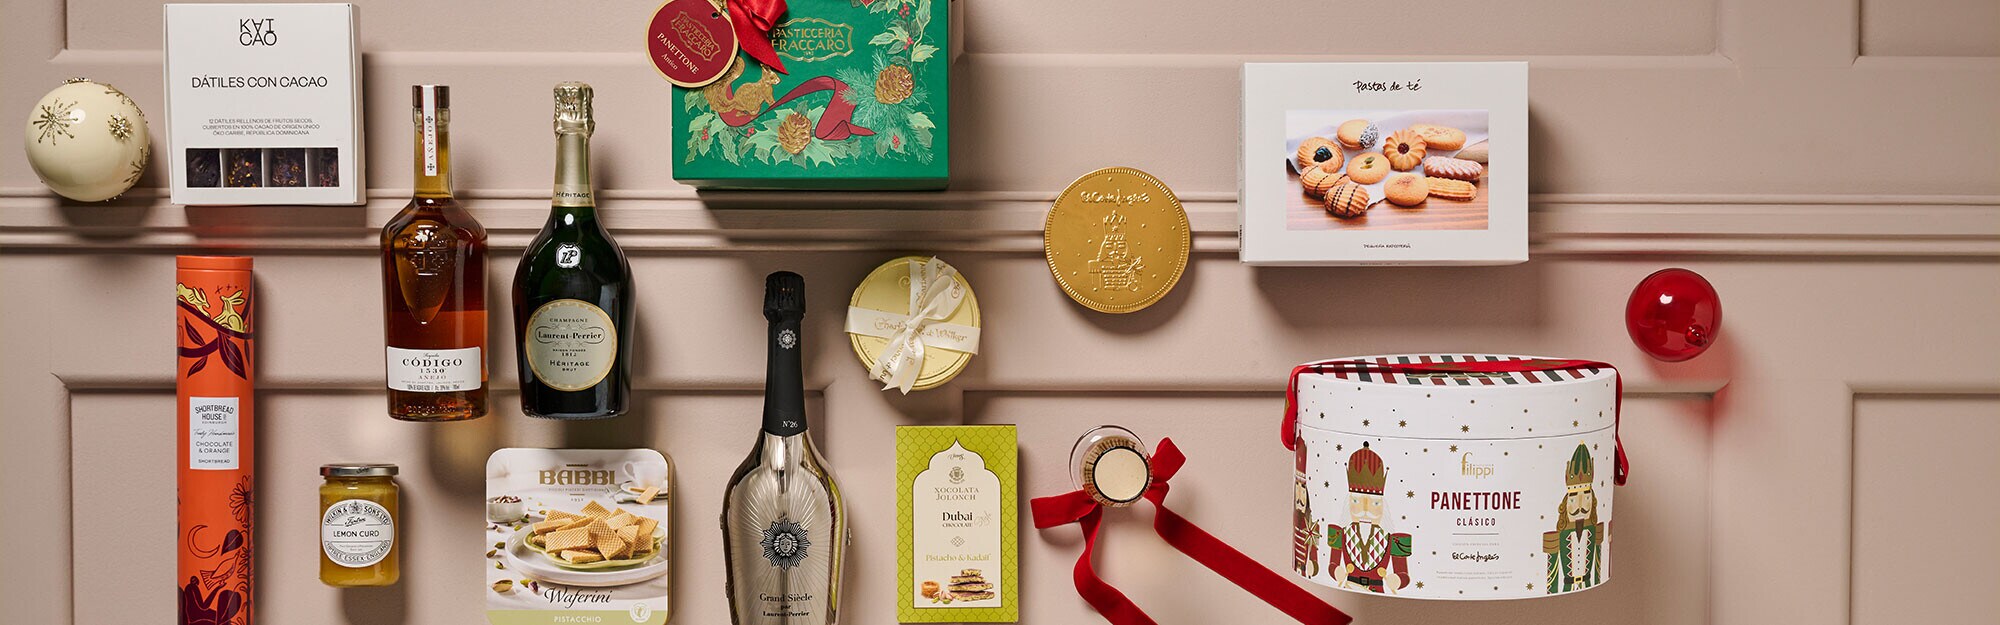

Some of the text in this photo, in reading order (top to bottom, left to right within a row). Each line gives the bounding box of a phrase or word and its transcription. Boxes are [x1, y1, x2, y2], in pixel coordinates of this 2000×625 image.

[239, 32, 277, 46] CAO
[675, 20, 711, 57] FRACCARO
[681, 15, 715, 51] PASTICCERIA
[772, 28, 844, 38] PASTICCERIA
[771, 39, 846, 52] FRACCARO
[657, 33, 700, 75] PANETTONE
[661, 53, 678, 71] Antico
[191, 74, 328, 88] DÁTILES CON CACAO
[1352, 78, 1422, 93] Pastas de té
[538, 331, 602, 339] Laurent-Perrier
[402, 357, 462, 367] CÓDIGO
[194, 404, 234, 414] SHORTBREAD
[1461, 451, 1494, 479] filippi
[539, 470, 615, 486] BABBI
[1430, 491, 1521, 510] PANETTONE
[364, 506, 380, 516] SONS
[942, 510, 972, 521] Dubai
[1456, 517, 1496, 527] CLÁSICO
[1452, 552, 1459, 560] El
[544, 586, 613, 608] Waferini
[759, 592, 813, 602] Grand Siècle
